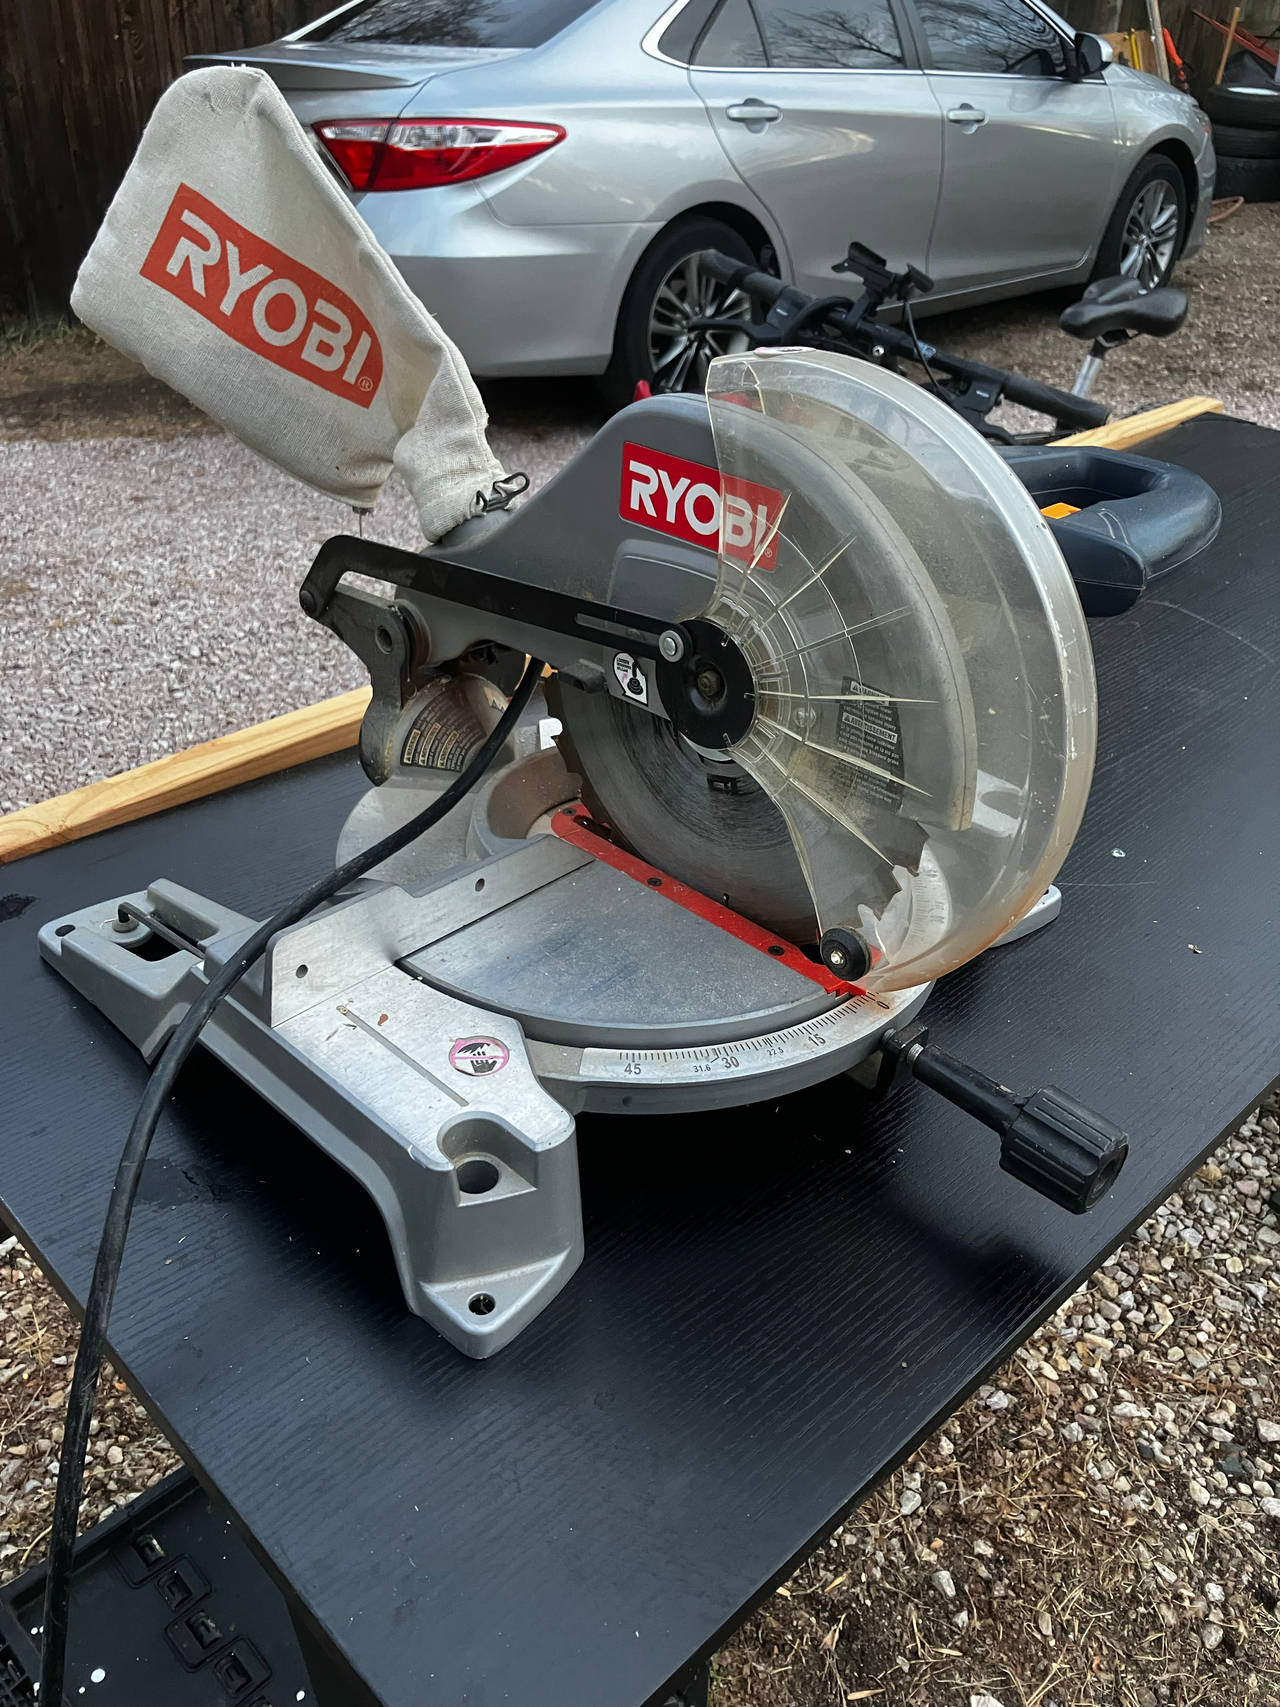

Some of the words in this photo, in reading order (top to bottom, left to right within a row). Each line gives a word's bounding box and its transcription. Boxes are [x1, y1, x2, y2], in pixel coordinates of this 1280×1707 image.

[166, 209, 372, 385] RYOBI
[629, 460, 768, 556] RYOBI
[808, 1033, 826, 1047] 15
[624, 1063, 642, 1075] 45
[693, 1063, 712, 1073] 31.6
[721, 1056, 740, 1069] 30
